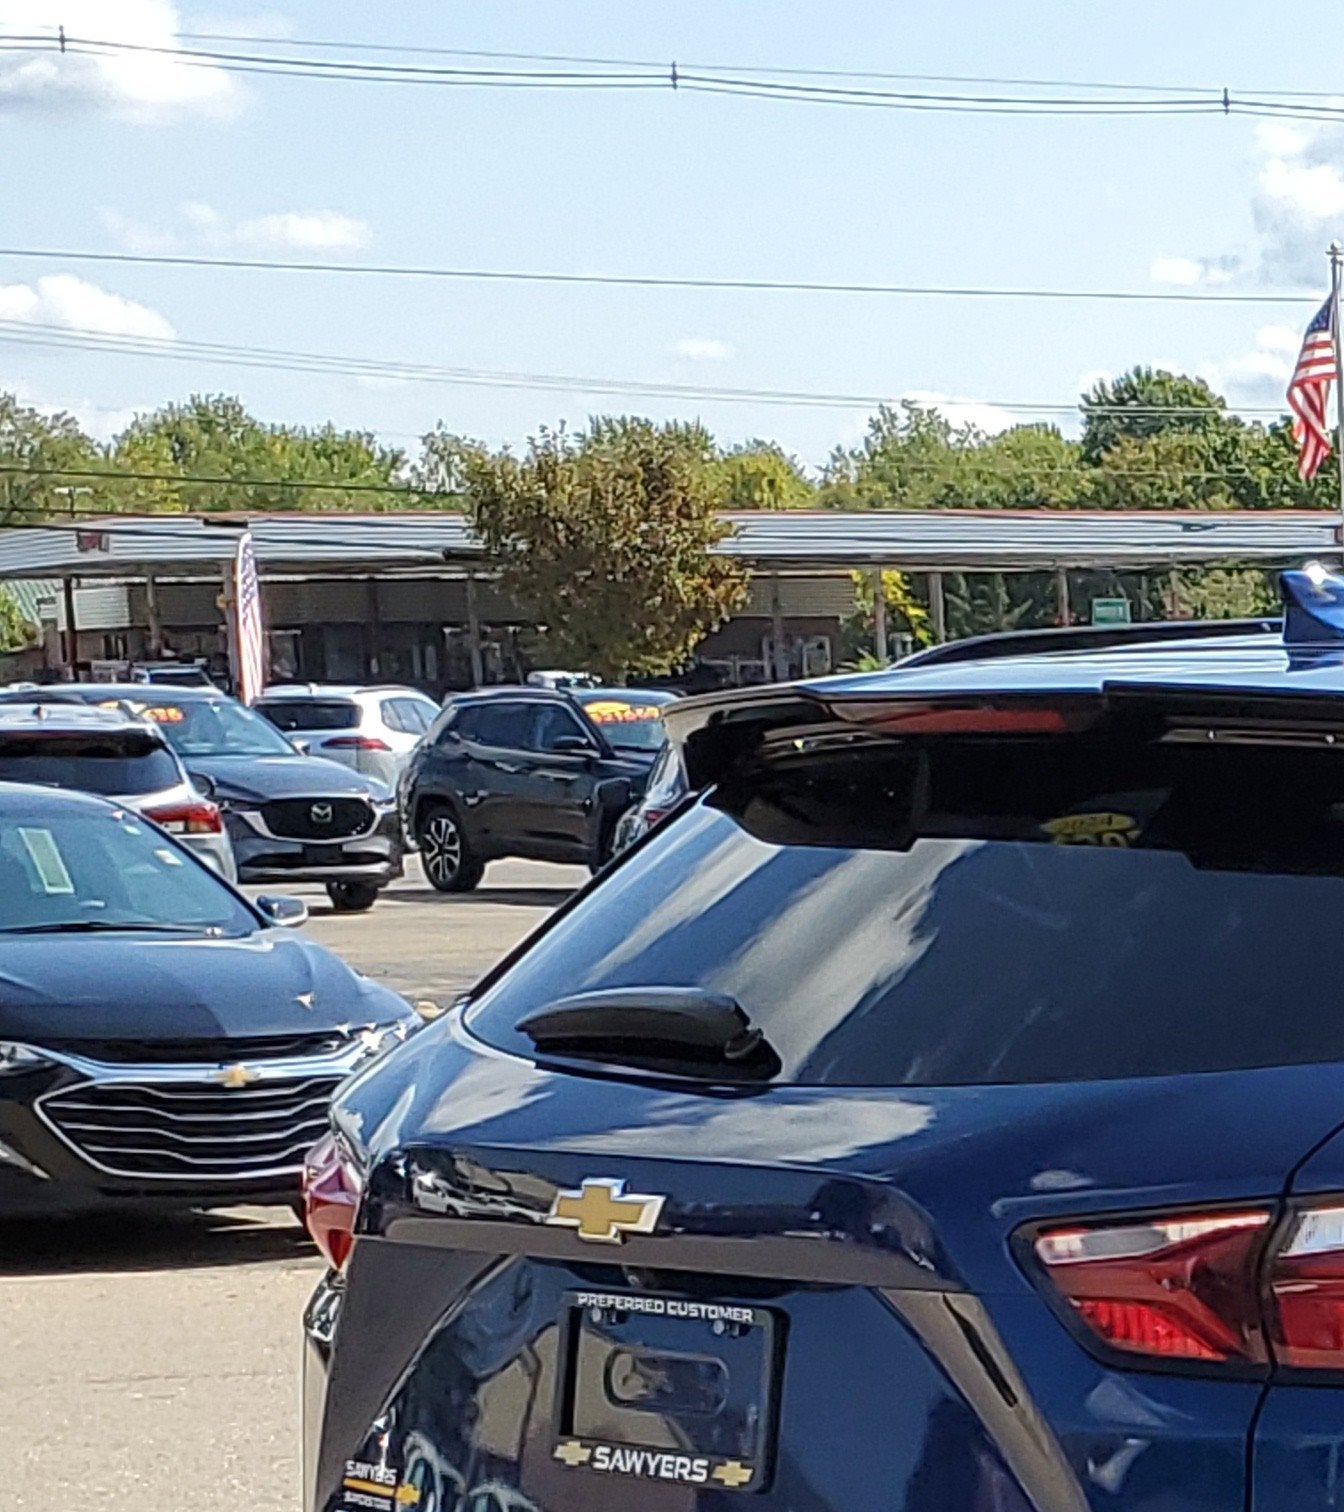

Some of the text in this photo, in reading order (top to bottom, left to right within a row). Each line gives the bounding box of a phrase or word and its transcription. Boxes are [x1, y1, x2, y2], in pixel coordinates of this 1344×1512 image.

[577, 1293, 753, 1322] PREFERRED CUSTOMER
[593, 1446, 709, 1482] SAWYERS
